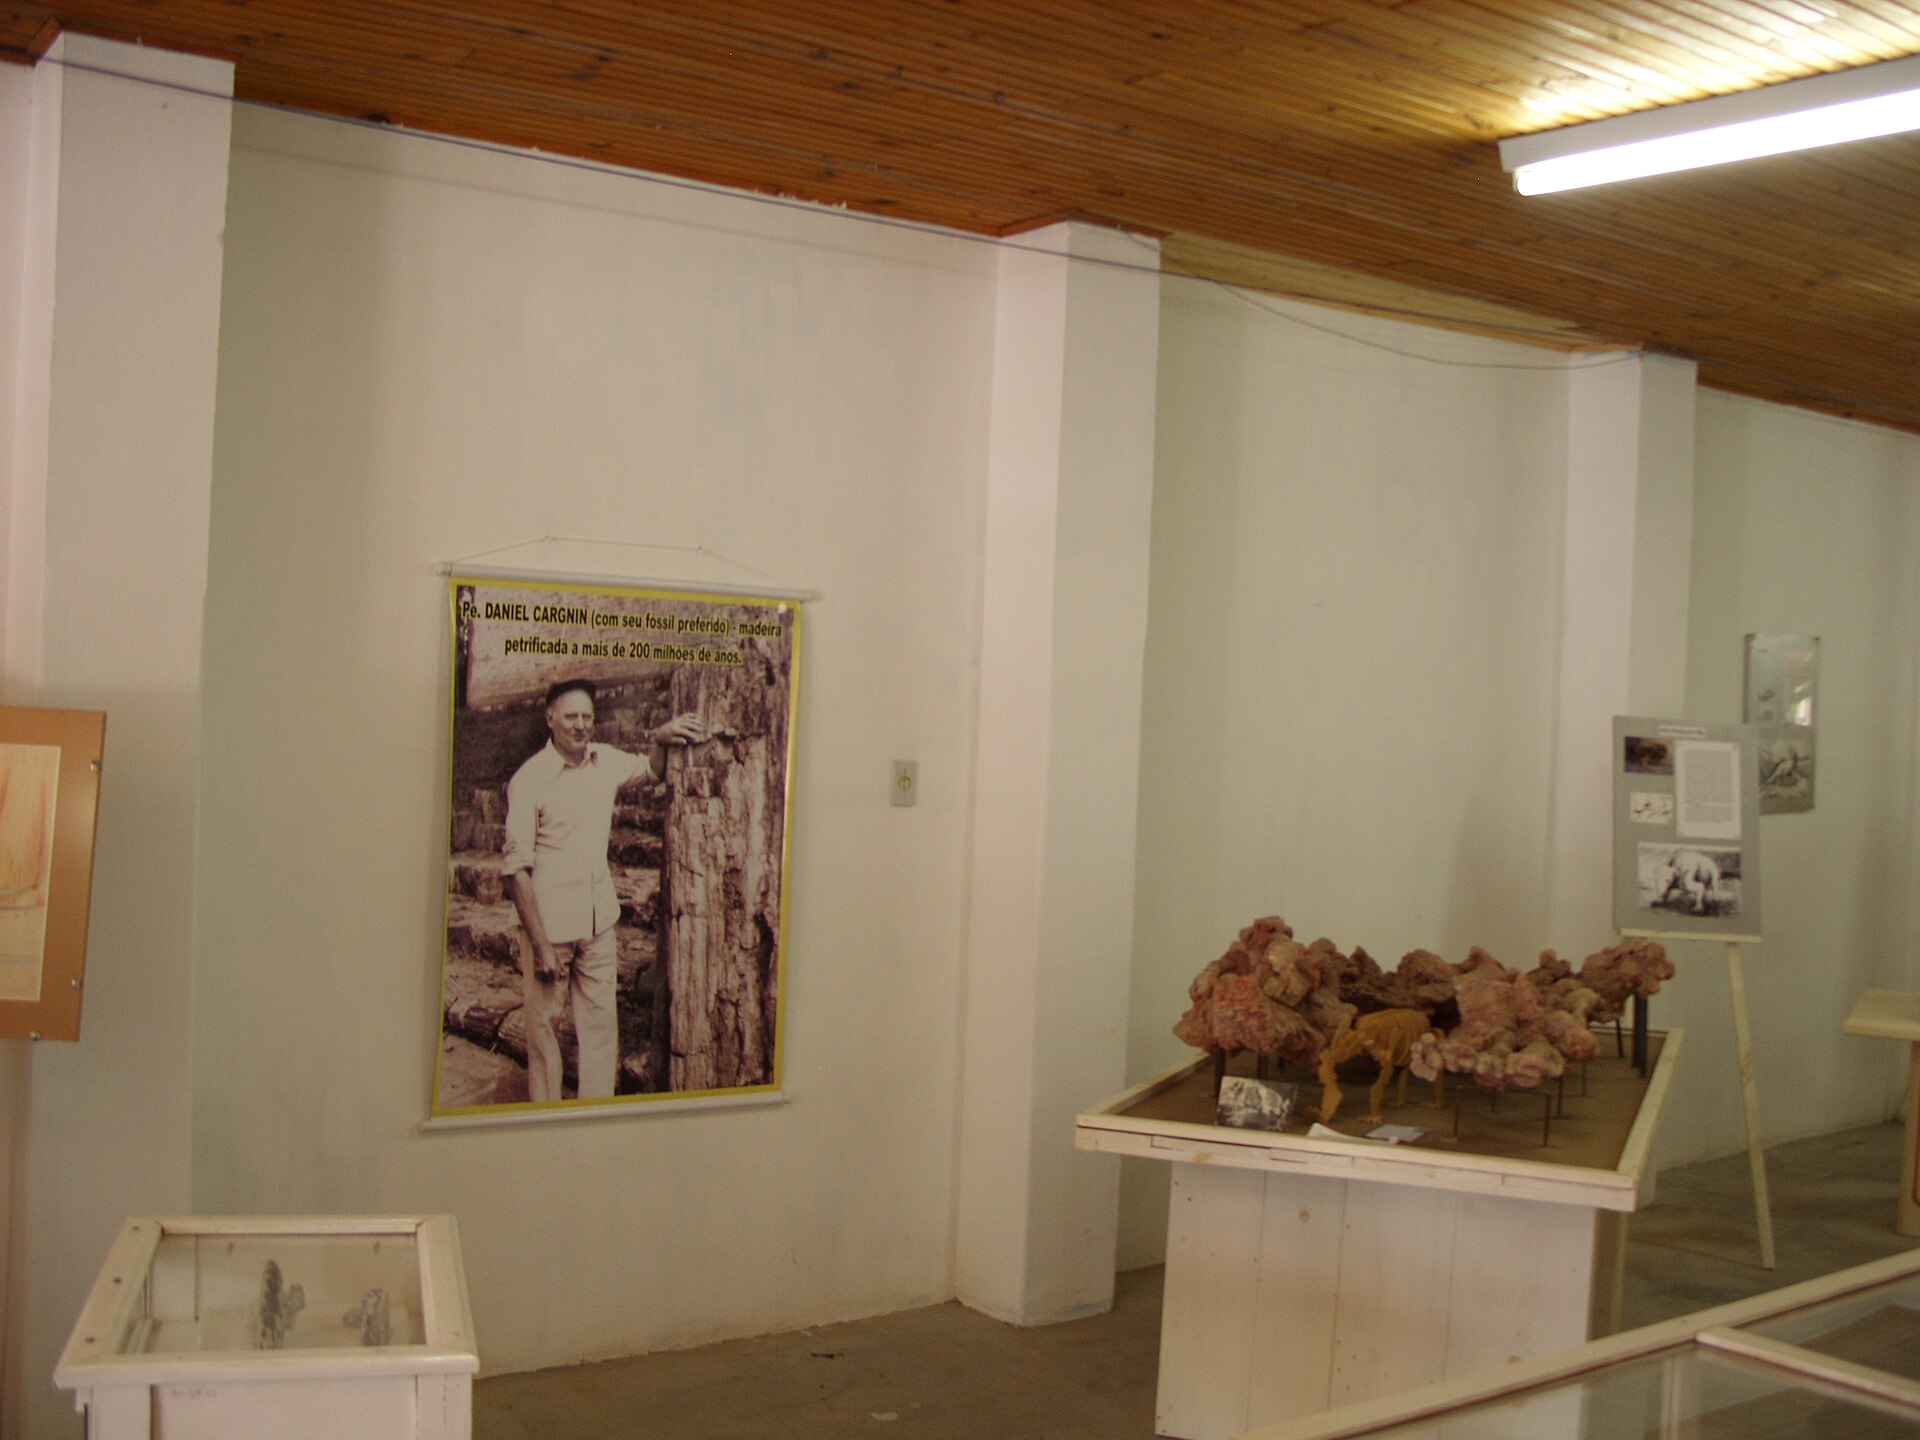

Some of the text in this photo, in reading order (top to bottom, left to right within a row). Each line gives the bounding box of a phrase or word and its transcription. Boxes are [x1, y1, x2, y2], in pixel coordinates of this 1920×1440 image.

[463, 601, 481, 619] Pe.
[485, 602, 529, 621] DANIEL
[533, 606, 588, 625] CARGNIN
[591, 609, 619, 629] (com
[622, 615, 642, 628] seu
[678, 616, 730, 638] preferido)
[739, 620, 782, 637] madeira
[505, 636, 742, 664] petrificada a mais de 200 milhões de anos.
